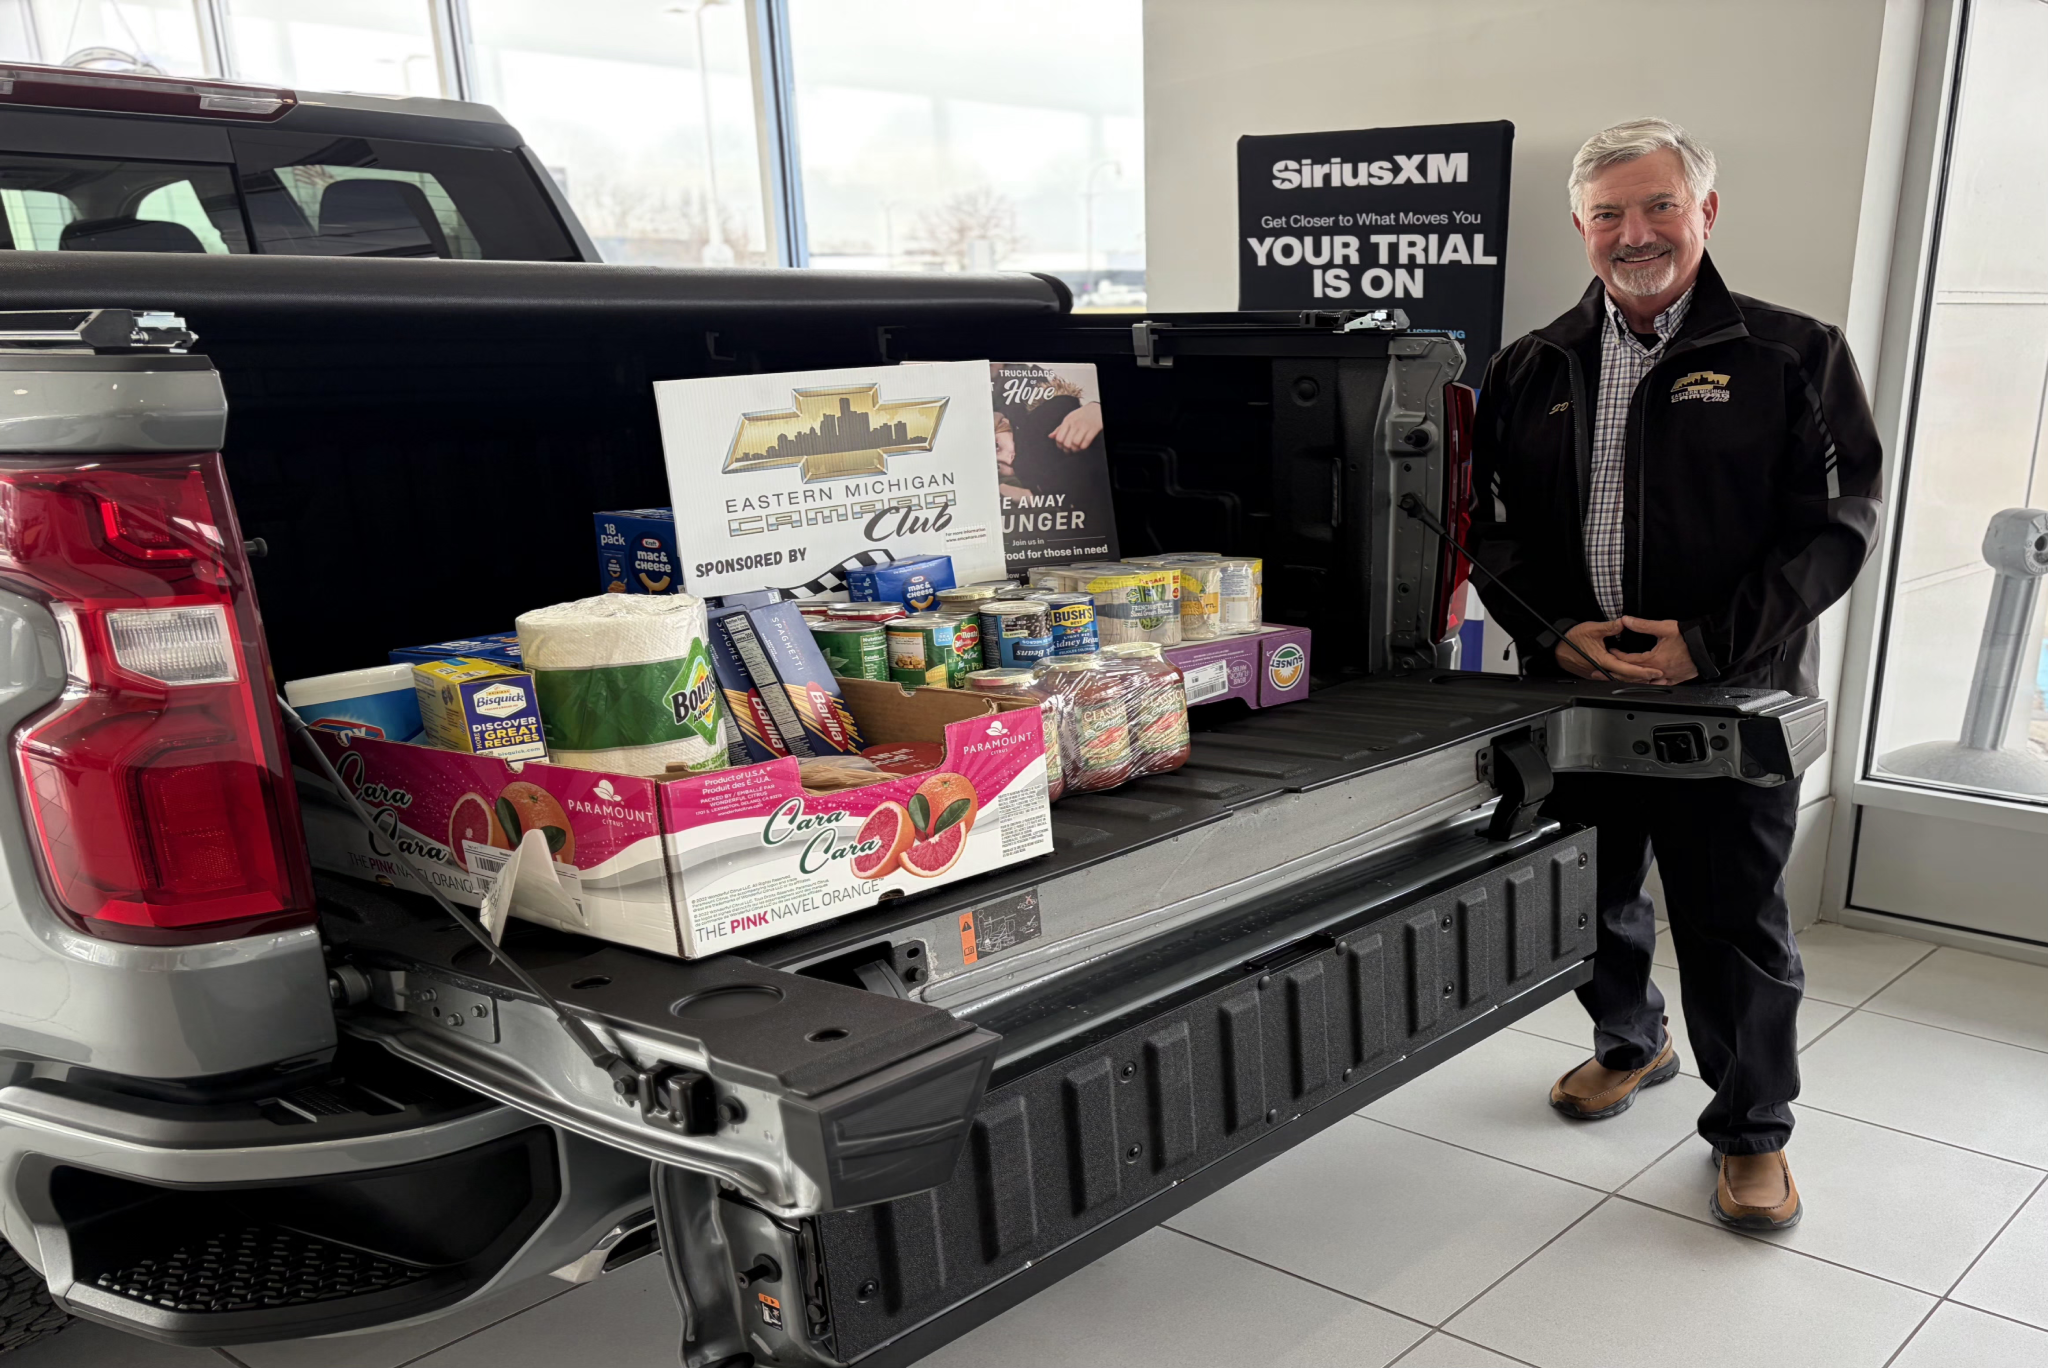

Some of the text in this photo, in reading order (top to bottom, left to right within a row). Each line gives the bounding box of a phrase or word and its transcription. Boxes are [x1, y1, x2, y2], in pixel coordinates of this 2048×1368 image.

[1272, 152, 1468, 189] SiriusXM
[1261, 211, 1481, 228] Get Closer to What Moves You
[1247, 234, 1497, 266] YOUR TRIAL
[1313, 268, 1424, 298] IS ON
[999, 369, 1055, 378] TRUCKLOADS
[1002, 378, 1055, 405] Hope
[726, 472, 955, 514] EASTERN MICHIGAN
[1018, 494, 1066, 509] AWAY
[728, 490, 957, 537] CAMARO
[863, 501, 953, 542] Club
[1001, 510, 1086, 534] UNGER
[604, 523, 616, 535] 18
[600, 533, 626, 546] pack
[1012, 539, 1027, 547] Join
[637, 550, 668, 562] mac &
[1027, 549, 1042, 559] for
[1043, 547, 1072, 558] those
[1073, 546, 1083, 556] in
[1084, 544, 1108, 554] need
[695, 547, 807, 579] SPONSORED BY
[907, 583, 925, 593] mac
[1053, 608, 1093, 624] BUSH'S
[771, 616, 804, 672] SPAGHETTI
[1016, 648, 1045, 657] Beans
[1270, 654, 1303, 668] SUNSET
[476, 692, 525, 708] Bisquick
[472, 716, 537, 732] DISCOVER
[751, 697, 784, 750] Barilla
[809, 691, 843, 743] Barilla
[474, 732, 483, 749] MORE
[484, 724, 538, 740] GREAT
[484, 733, 540, 748] RECIPES
[498, 747, 541, 756] bisquick.com
[964, 731, 1033, 755] PARAMOUNT
[990, 747, 1009, 755] CITRUS
[336, 751, 412, 807] Cara
[704, 774, 734, 786] Product
[744, 768, 766, 778] U.S.A.
[702, 783, 730, 795] Produit
[731, 780, 745, 789] des
[568, 798, 653, 825] PARAMOUNT
[602, 818, 624, 828] CITRUS
[763, 798, 846, 846] Cara
[368, 806, 448, 863] Cara
[799, 828, 880, 874] Cara
[348, 851, 369, 869] THE
[369, 857, 396, 875] PINK
[432, 870, 480, 895] ORANG
[696, 921, 728, 942] THE
[730, 910, 770, 934] PINK
[770, 898, 820, 921] NAVEL
